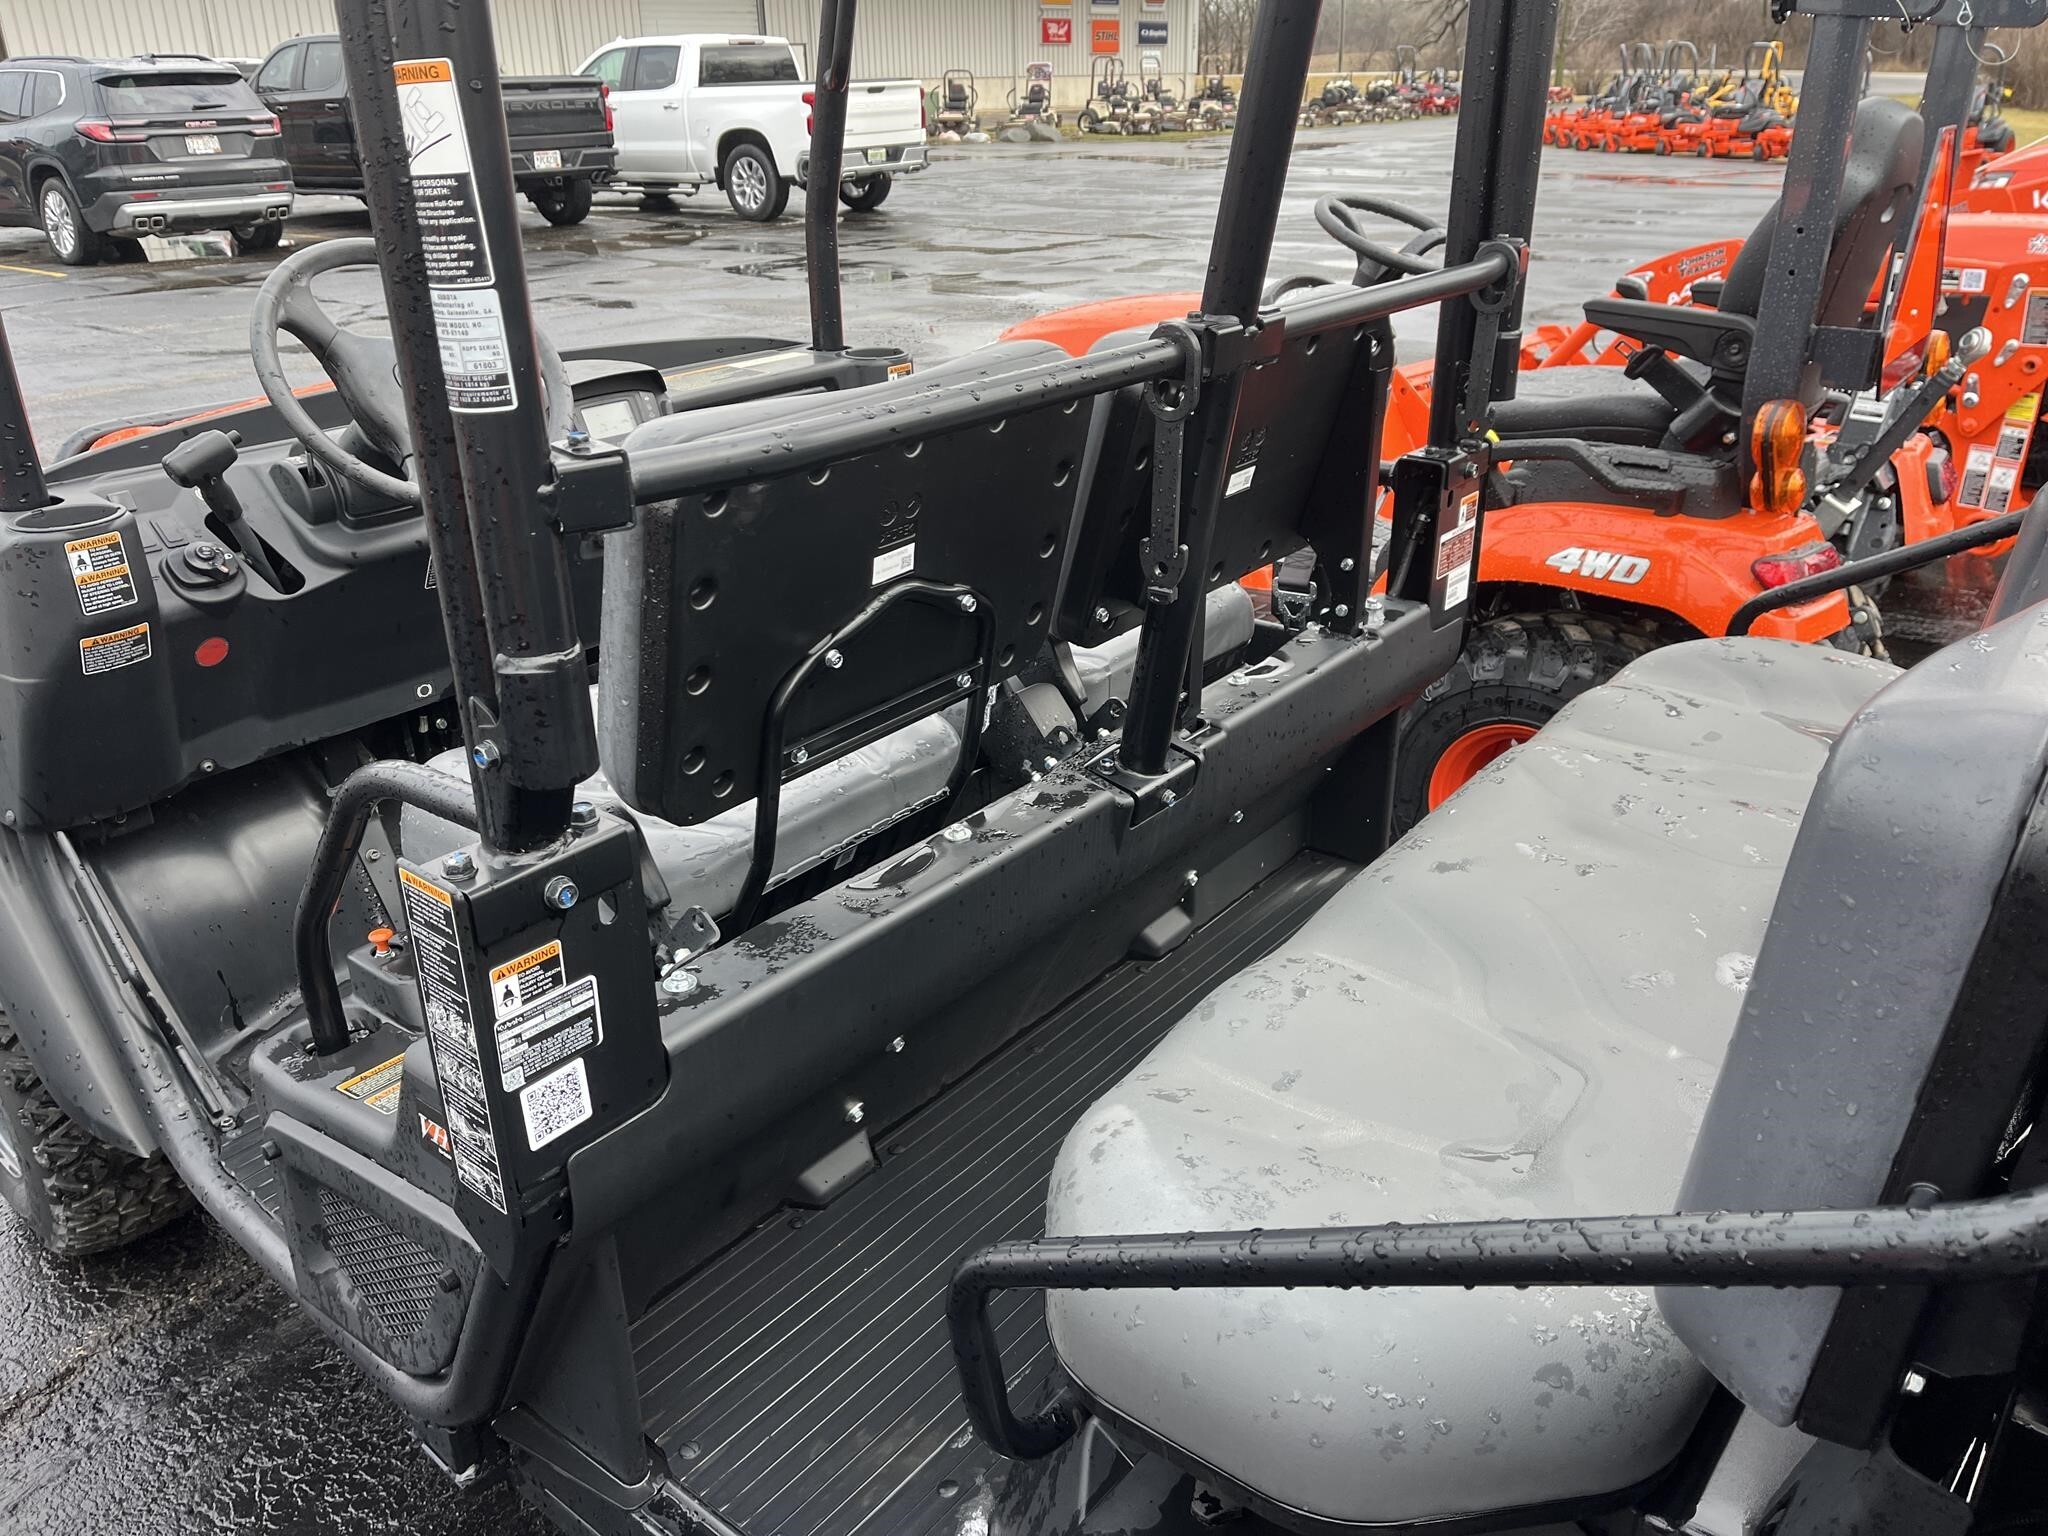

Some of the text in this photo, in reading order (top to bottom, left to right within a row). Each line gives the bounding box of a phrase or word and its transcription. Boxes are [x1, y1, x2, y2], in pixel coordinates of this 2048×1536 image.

[1095, 31, 1119, 41] STIHL
[396, 65, 441, 82] ARNING
[503, 100, 594, 111] HEVROLET
[185, 120, 218, 128] GMC
[420, 178, 459, 187] PERSONAL
[1678, 246, 1725, 268] JOHNSON
[1678, 258, 1727, 278] TRACTOR
[78, 535, 118, 550] WARNING
[1544, 546, 1652, 585] 4WD
[87, 566, 126, 582] WARNING
[100, 628, 140, 643] WARNING
[410, 877, 448, 902] WARNING
[506, 945, 557, 975] WARNING
[518, 969, 545, 984] PERSONAL
[525, 965, 541, 975] AVOID
[519, 966, 561, 990] INJURY OR DEATH
[520, 984, 537, 995] Always
[497, 1016, 524, 1032] Kubota
